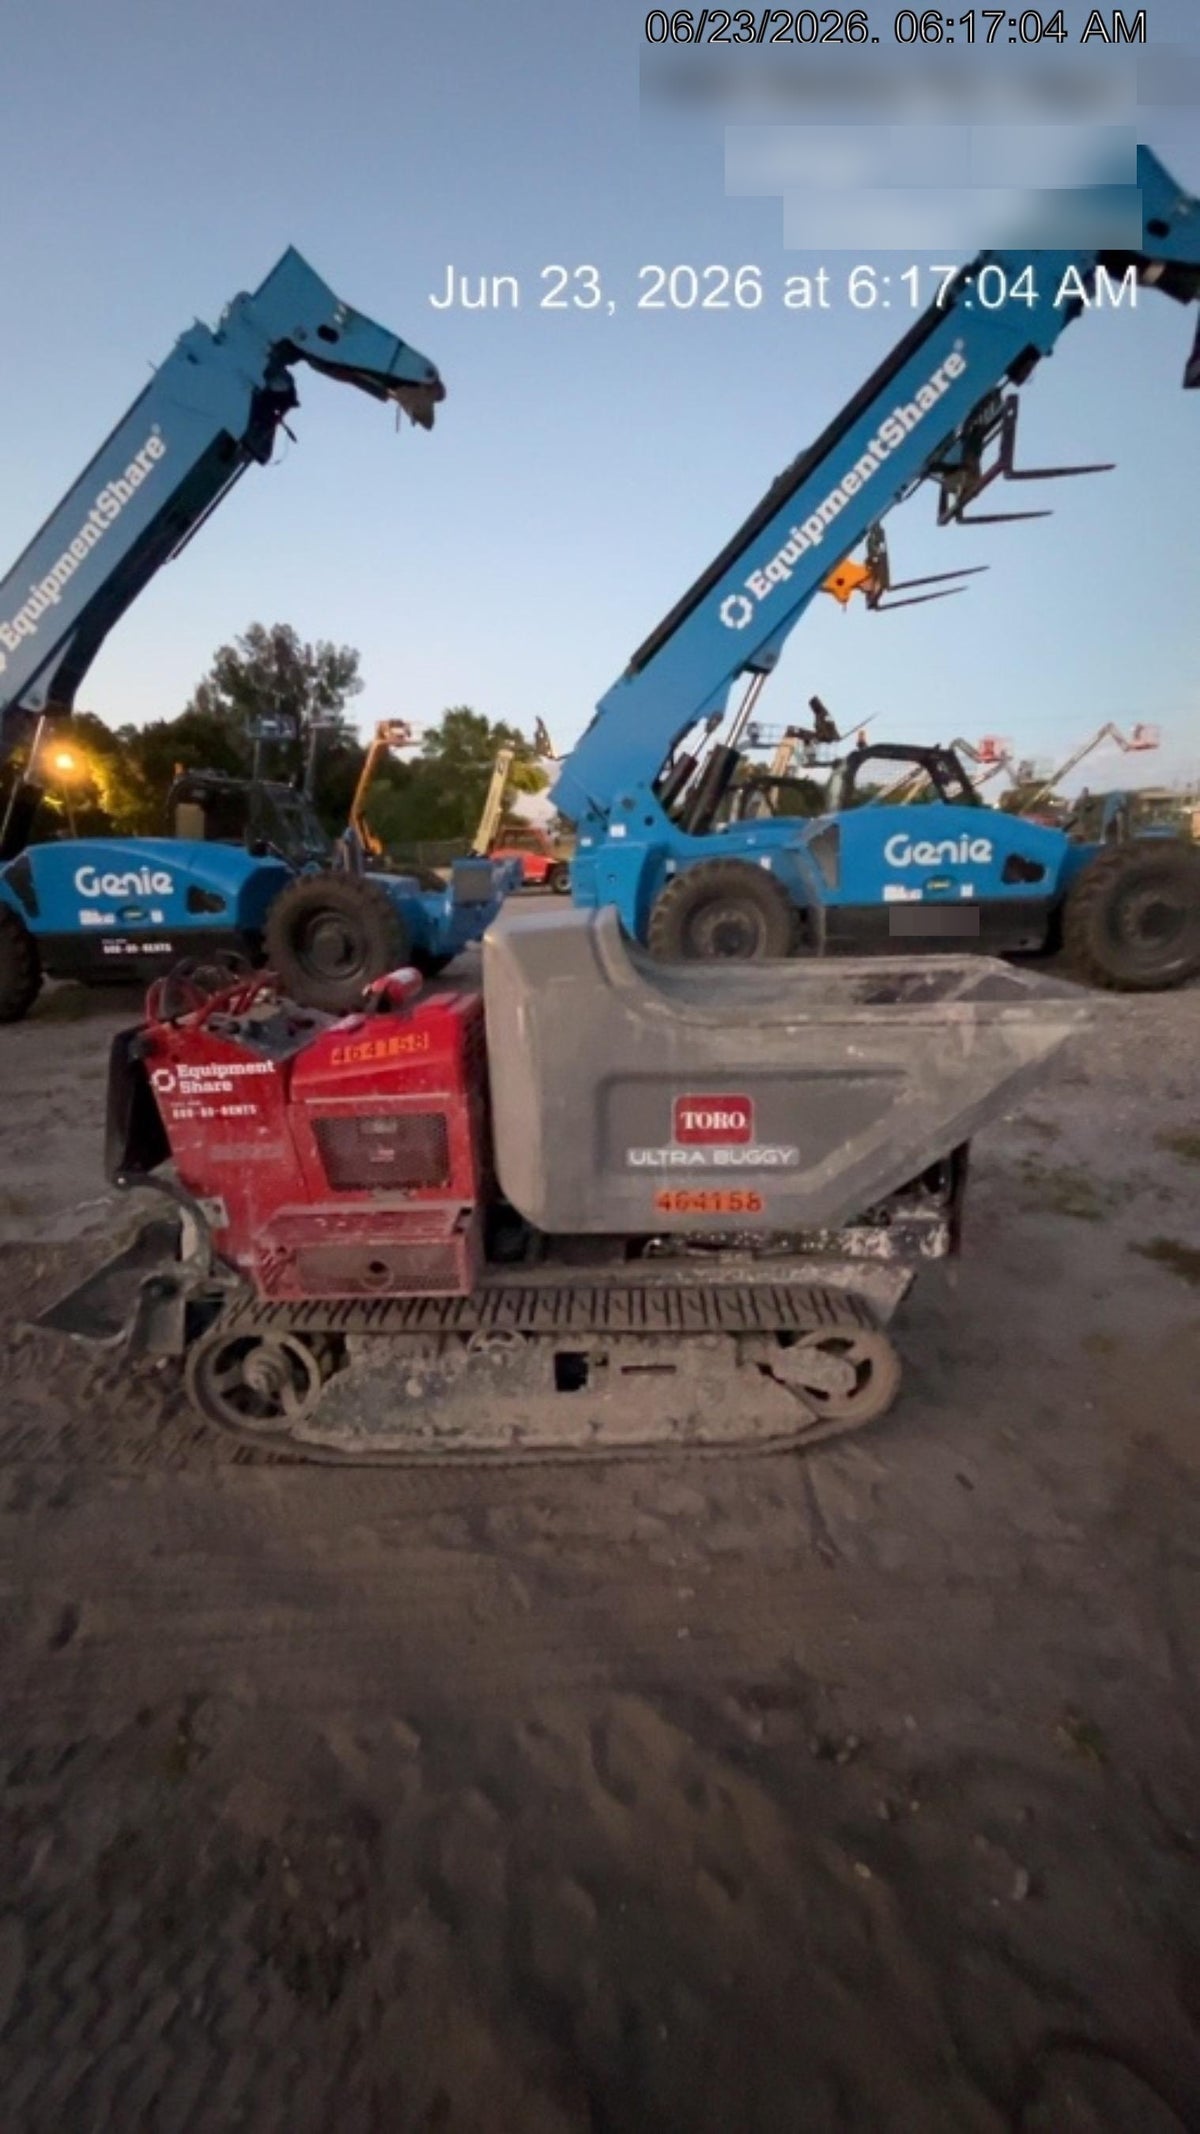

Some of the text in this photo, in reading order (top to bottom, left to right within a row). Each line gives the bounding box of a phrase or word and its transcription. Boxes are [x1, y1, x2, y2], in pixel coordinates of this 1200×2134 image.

[744, 352, 966, 600] EquipmentShare
[883, 833, 993, 867] Genie
[74, 866, 173, 897] Genie
[176, 1060, 275, 1079] Equipment
[180, 1081, 234, 1094] Share
[680, 1111, 746, 1130] TORO
[629, 1149, 794, 1166] ULTRA BUGGY
